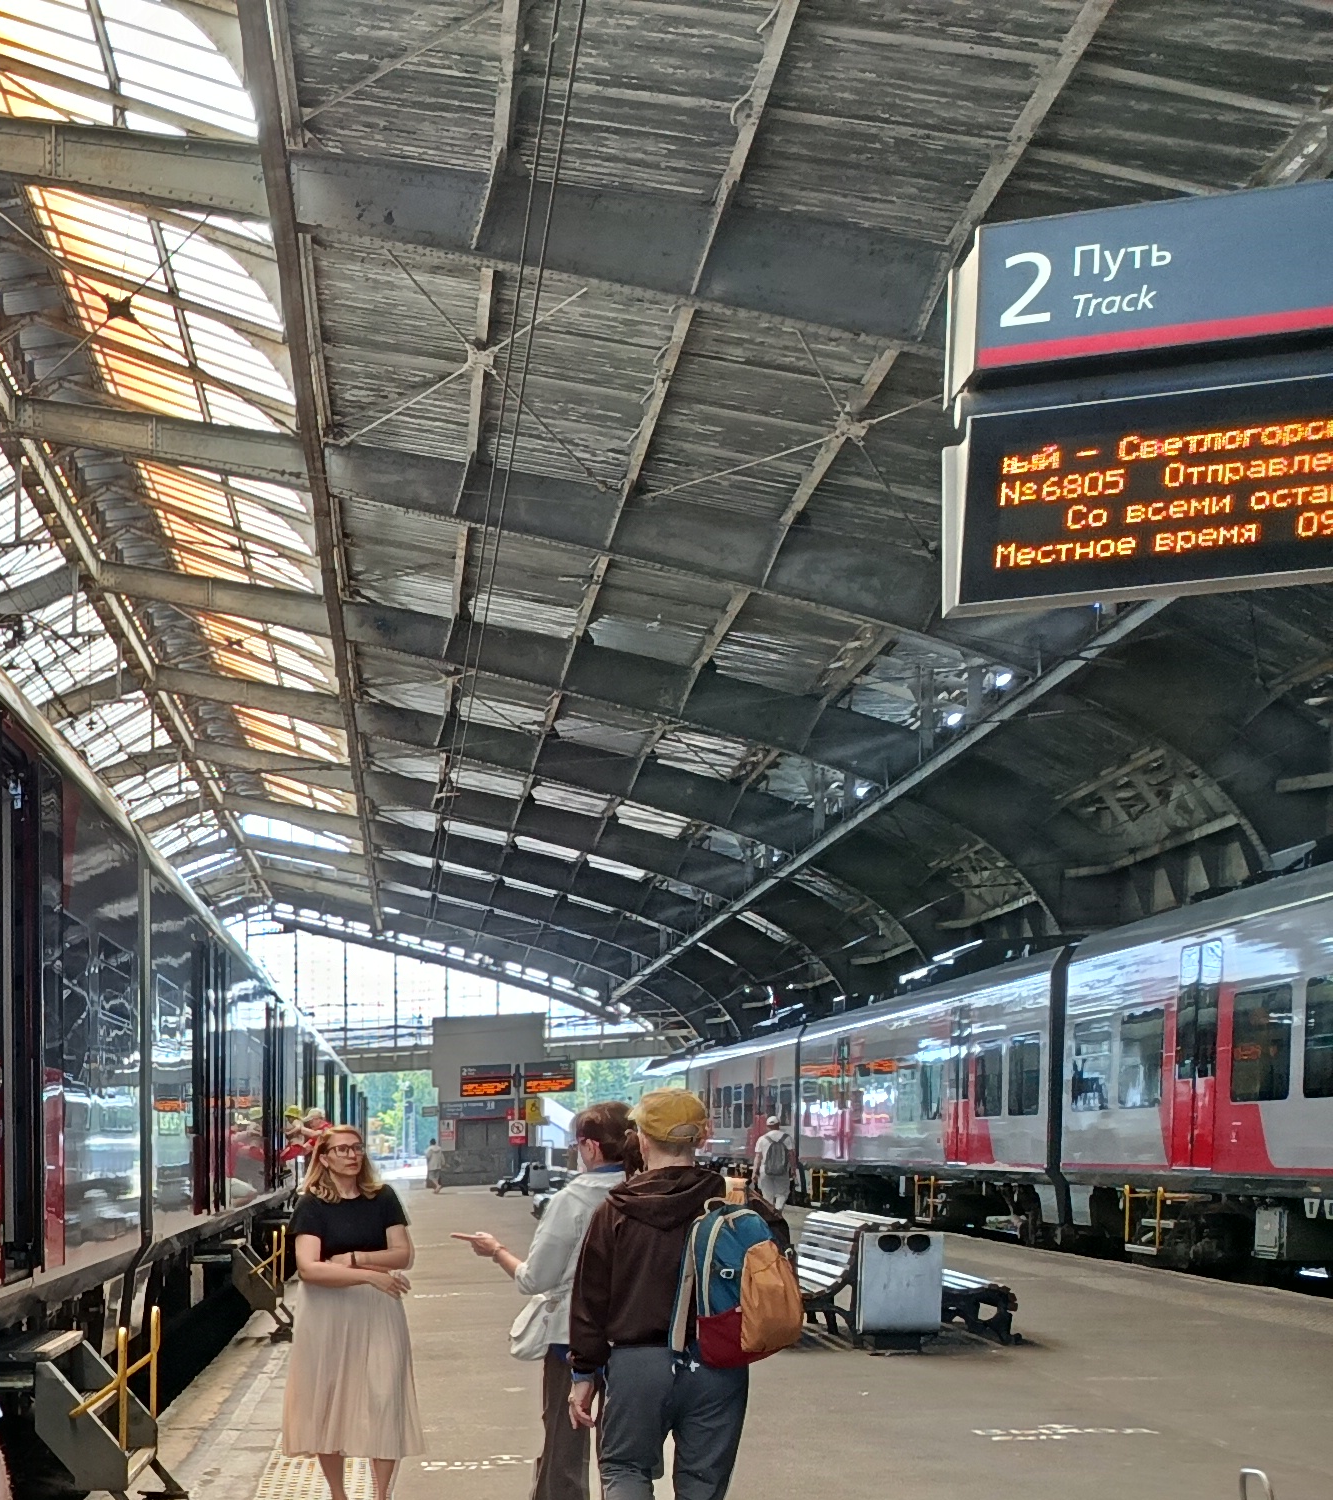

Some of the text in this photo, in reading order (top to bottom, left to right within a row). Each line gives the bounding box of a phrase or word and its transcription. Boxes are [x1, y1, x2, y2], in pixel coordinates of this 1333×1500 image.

[1000, 243, 1172, 328] 2 Путь
[1072, 284, 1157, 319] Track
[1067, 484, 1333, 530] Со всеми оста
[995, 537, 1137, 568] Местное
[1155, 523, 1258, 553] время
